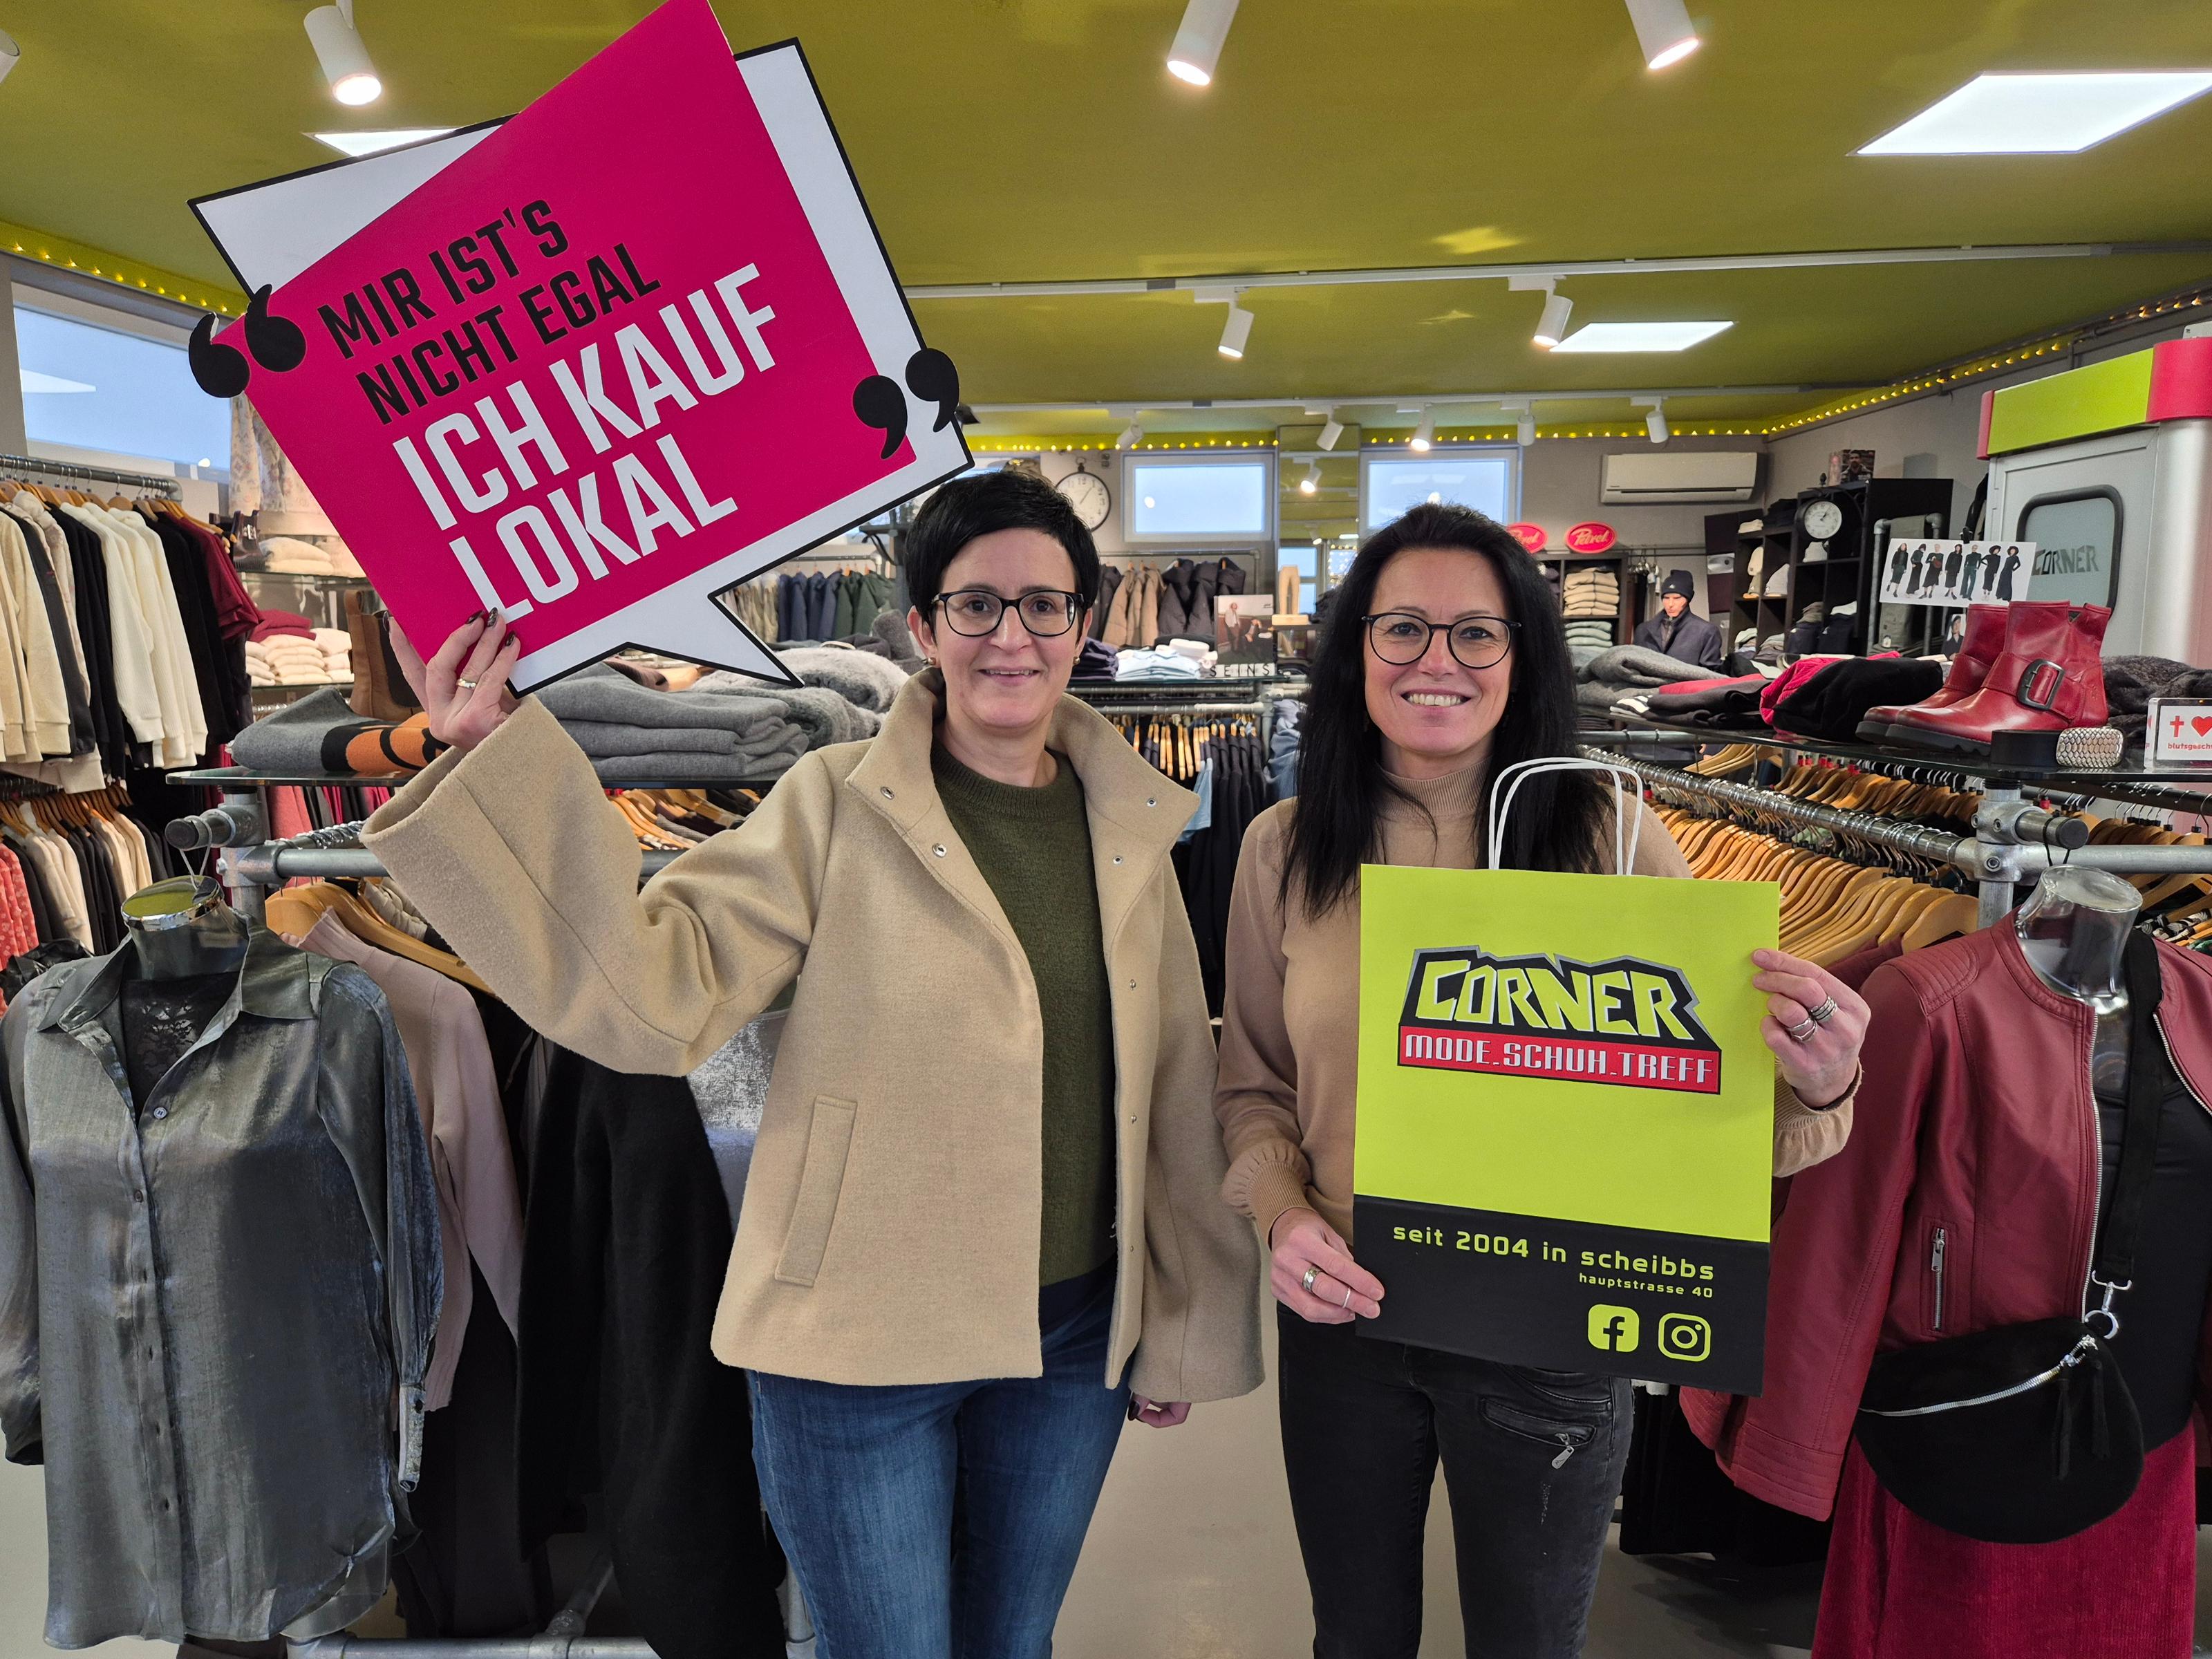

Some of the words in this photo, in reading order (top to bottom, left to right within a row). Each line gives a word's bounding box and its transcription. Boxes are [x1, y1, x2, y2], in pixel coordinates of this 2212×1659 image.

[317, 268, 437, 359] MIR
[429, 200, 568, 305] IST'S
[356, 305, 518, 425] NICHT
[518, 243, 662, 345] EGAL
[393, 379, 570, 531] ICH
[548, 263, 776, 454] KAUF
[449, 433, 738, 624] LOKAL
[2032, 545, 2099, 576] CORNER
[2168, 742, 2212, 751] blutsgesch
[1415, 959, 1694, 1041] CORNER
[1394, 1226, 1443, 1246] seit
[1456, 1230, 1529, 1257] 2004
[1543, 1241, 1566, 1263] in
[1581, 1250, 1714, 1280] scheibbs
[1579, 1273, 1685, 1295] hauptstrasse
[1691, 1286, 1713, 1298] 40
